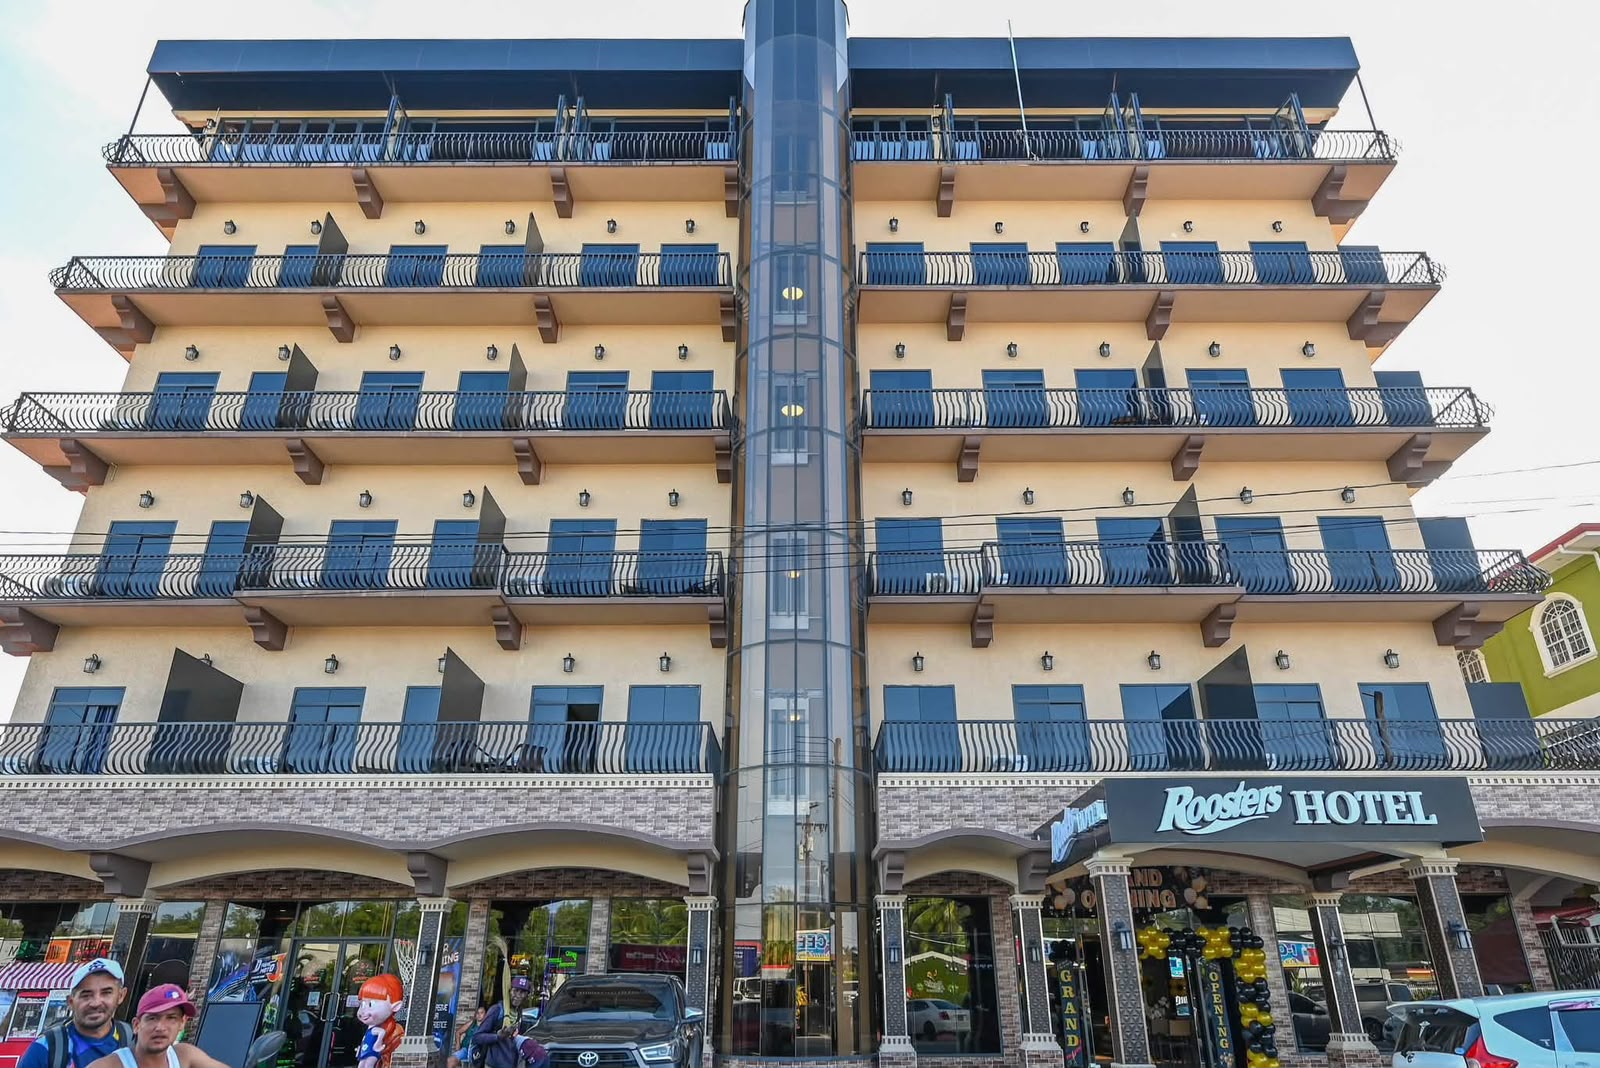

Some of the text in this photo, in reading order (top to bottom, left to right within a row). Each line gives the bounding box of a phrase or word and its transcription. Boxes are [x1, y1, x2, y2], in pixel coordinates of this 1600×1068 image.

[1156, 780, 1283, 834] Roosters
[1290, 790, 1439, 825] HOTEL
[1060, 970, 1082, 1047] GRAND
[1209, 972, 1229, 1049] OPENING
